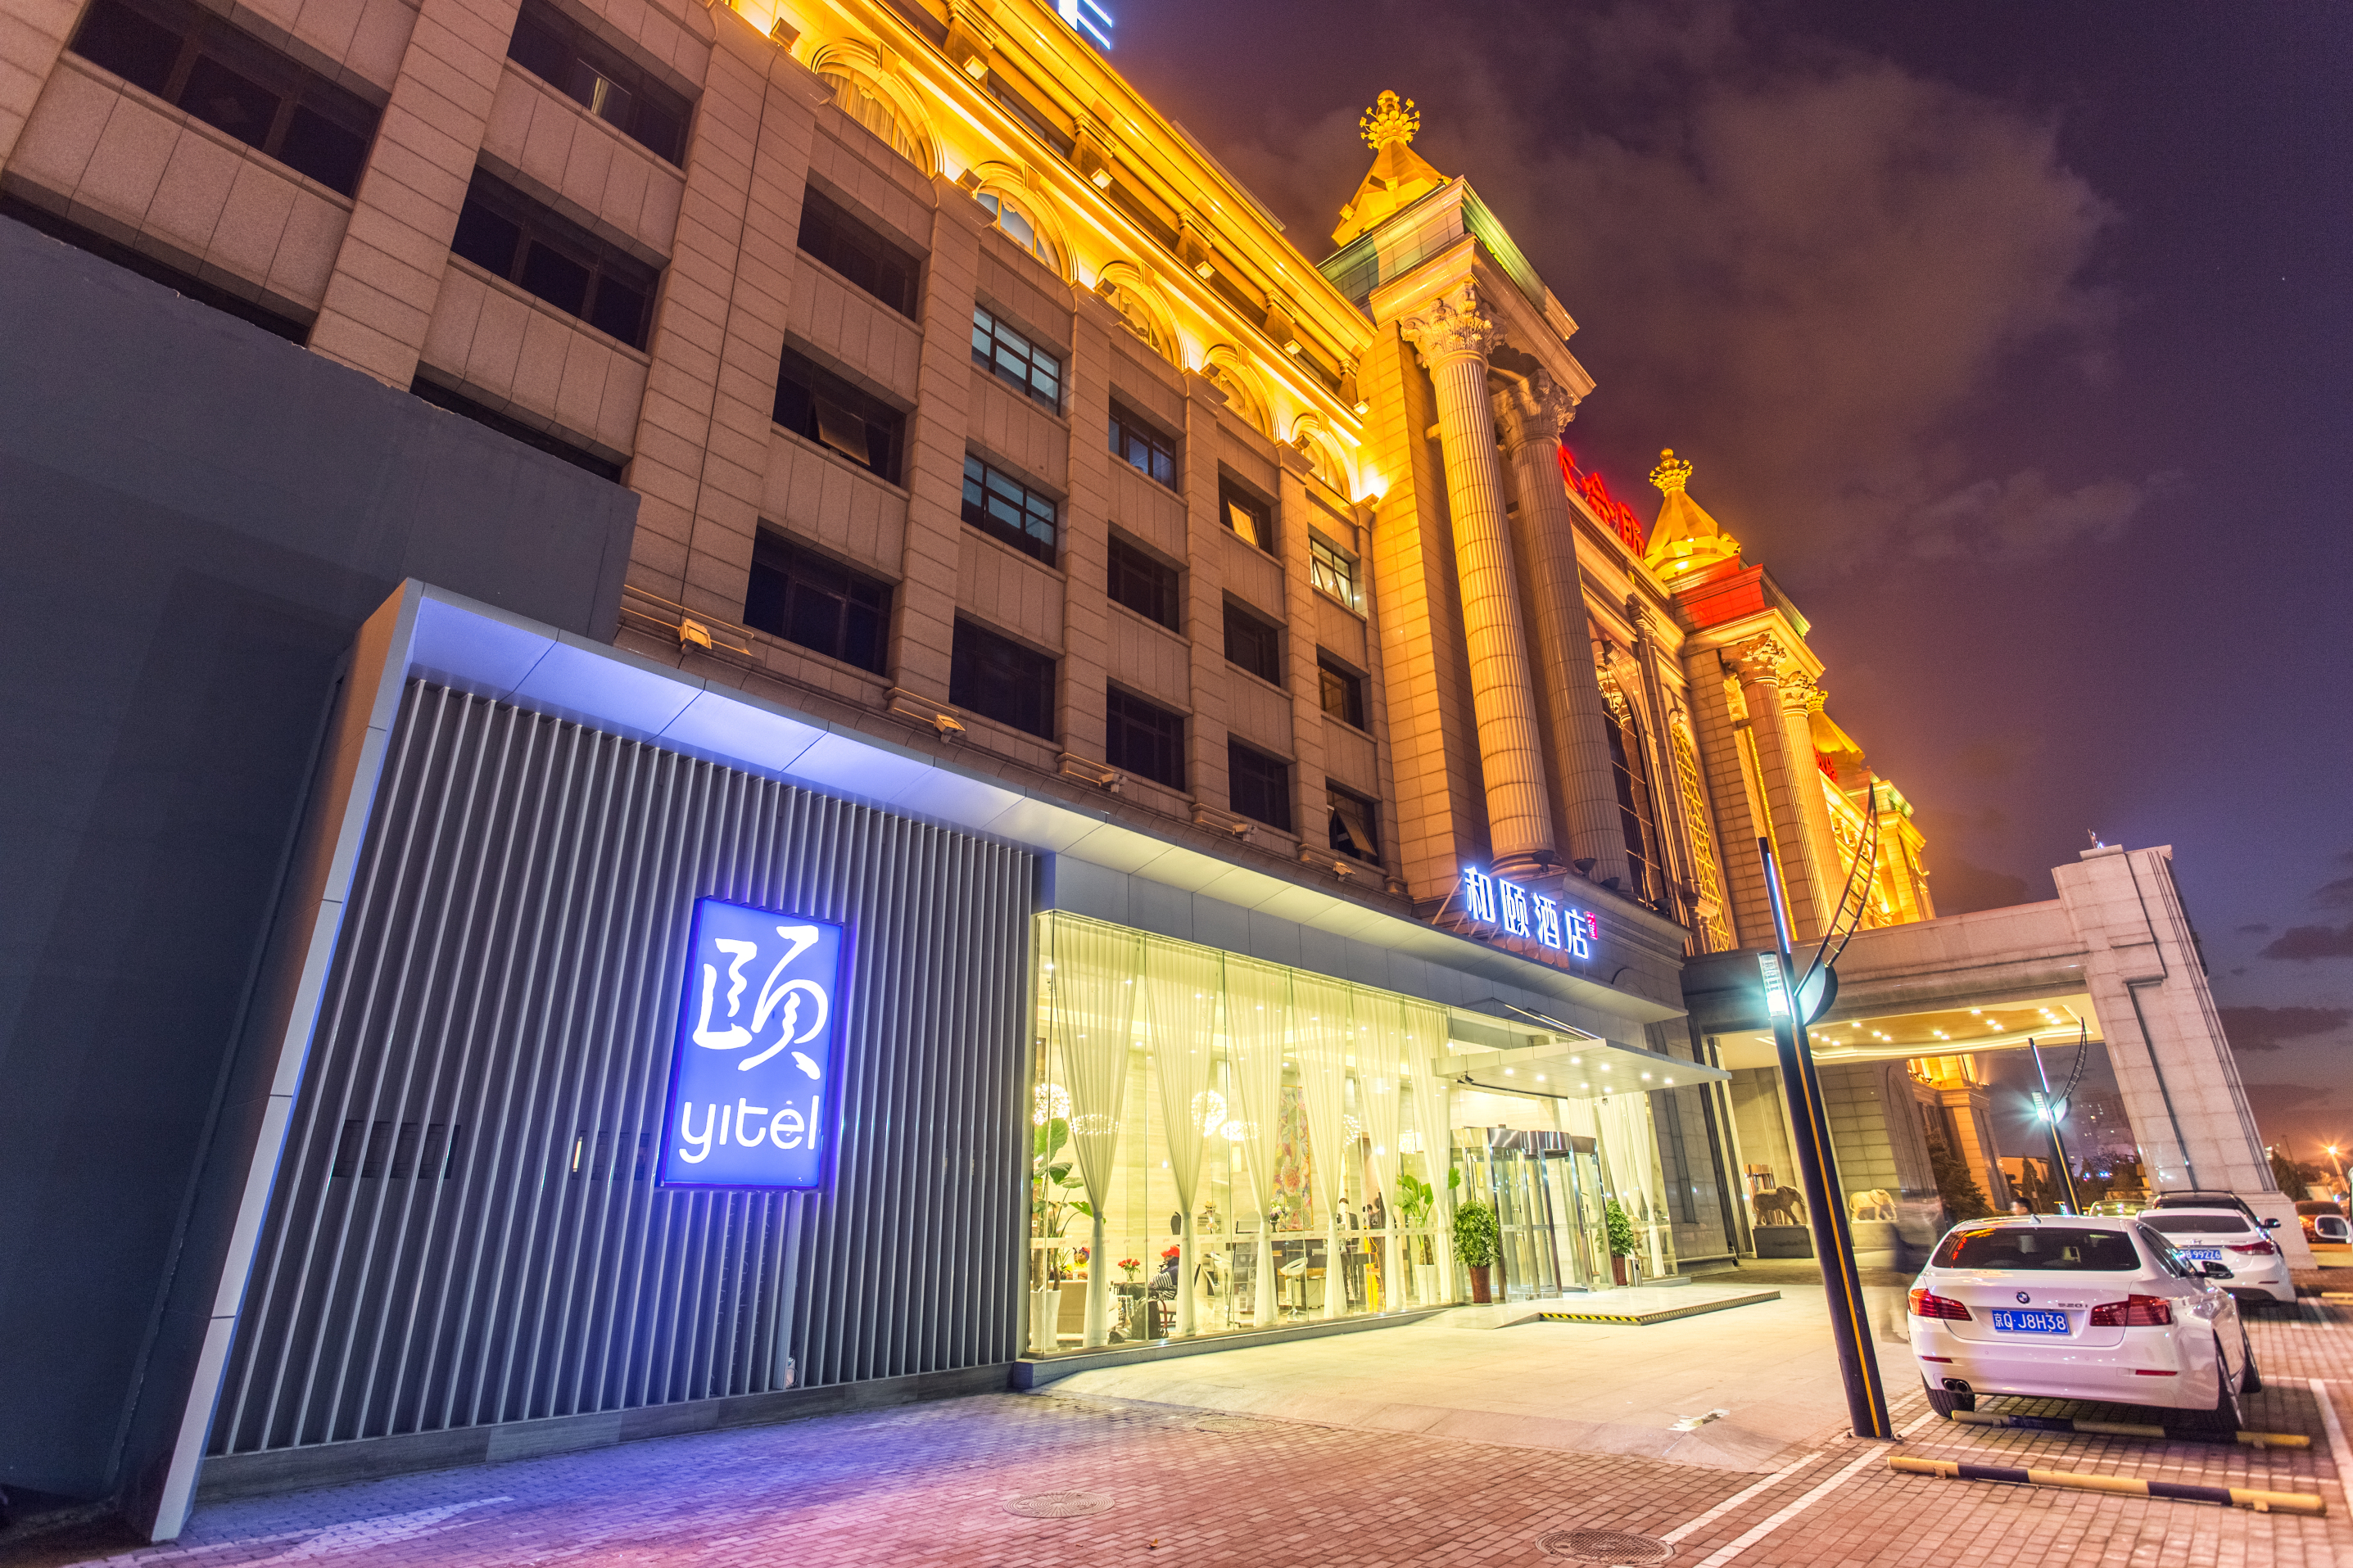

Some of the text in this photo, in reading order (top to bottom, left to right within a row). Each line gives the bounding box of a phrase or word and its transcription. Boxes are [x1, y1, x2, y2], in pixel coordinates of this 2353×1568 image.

[1464, 866, 1589, 960] 和颐酒店
[679, 1095, 820, 1164] yitel
